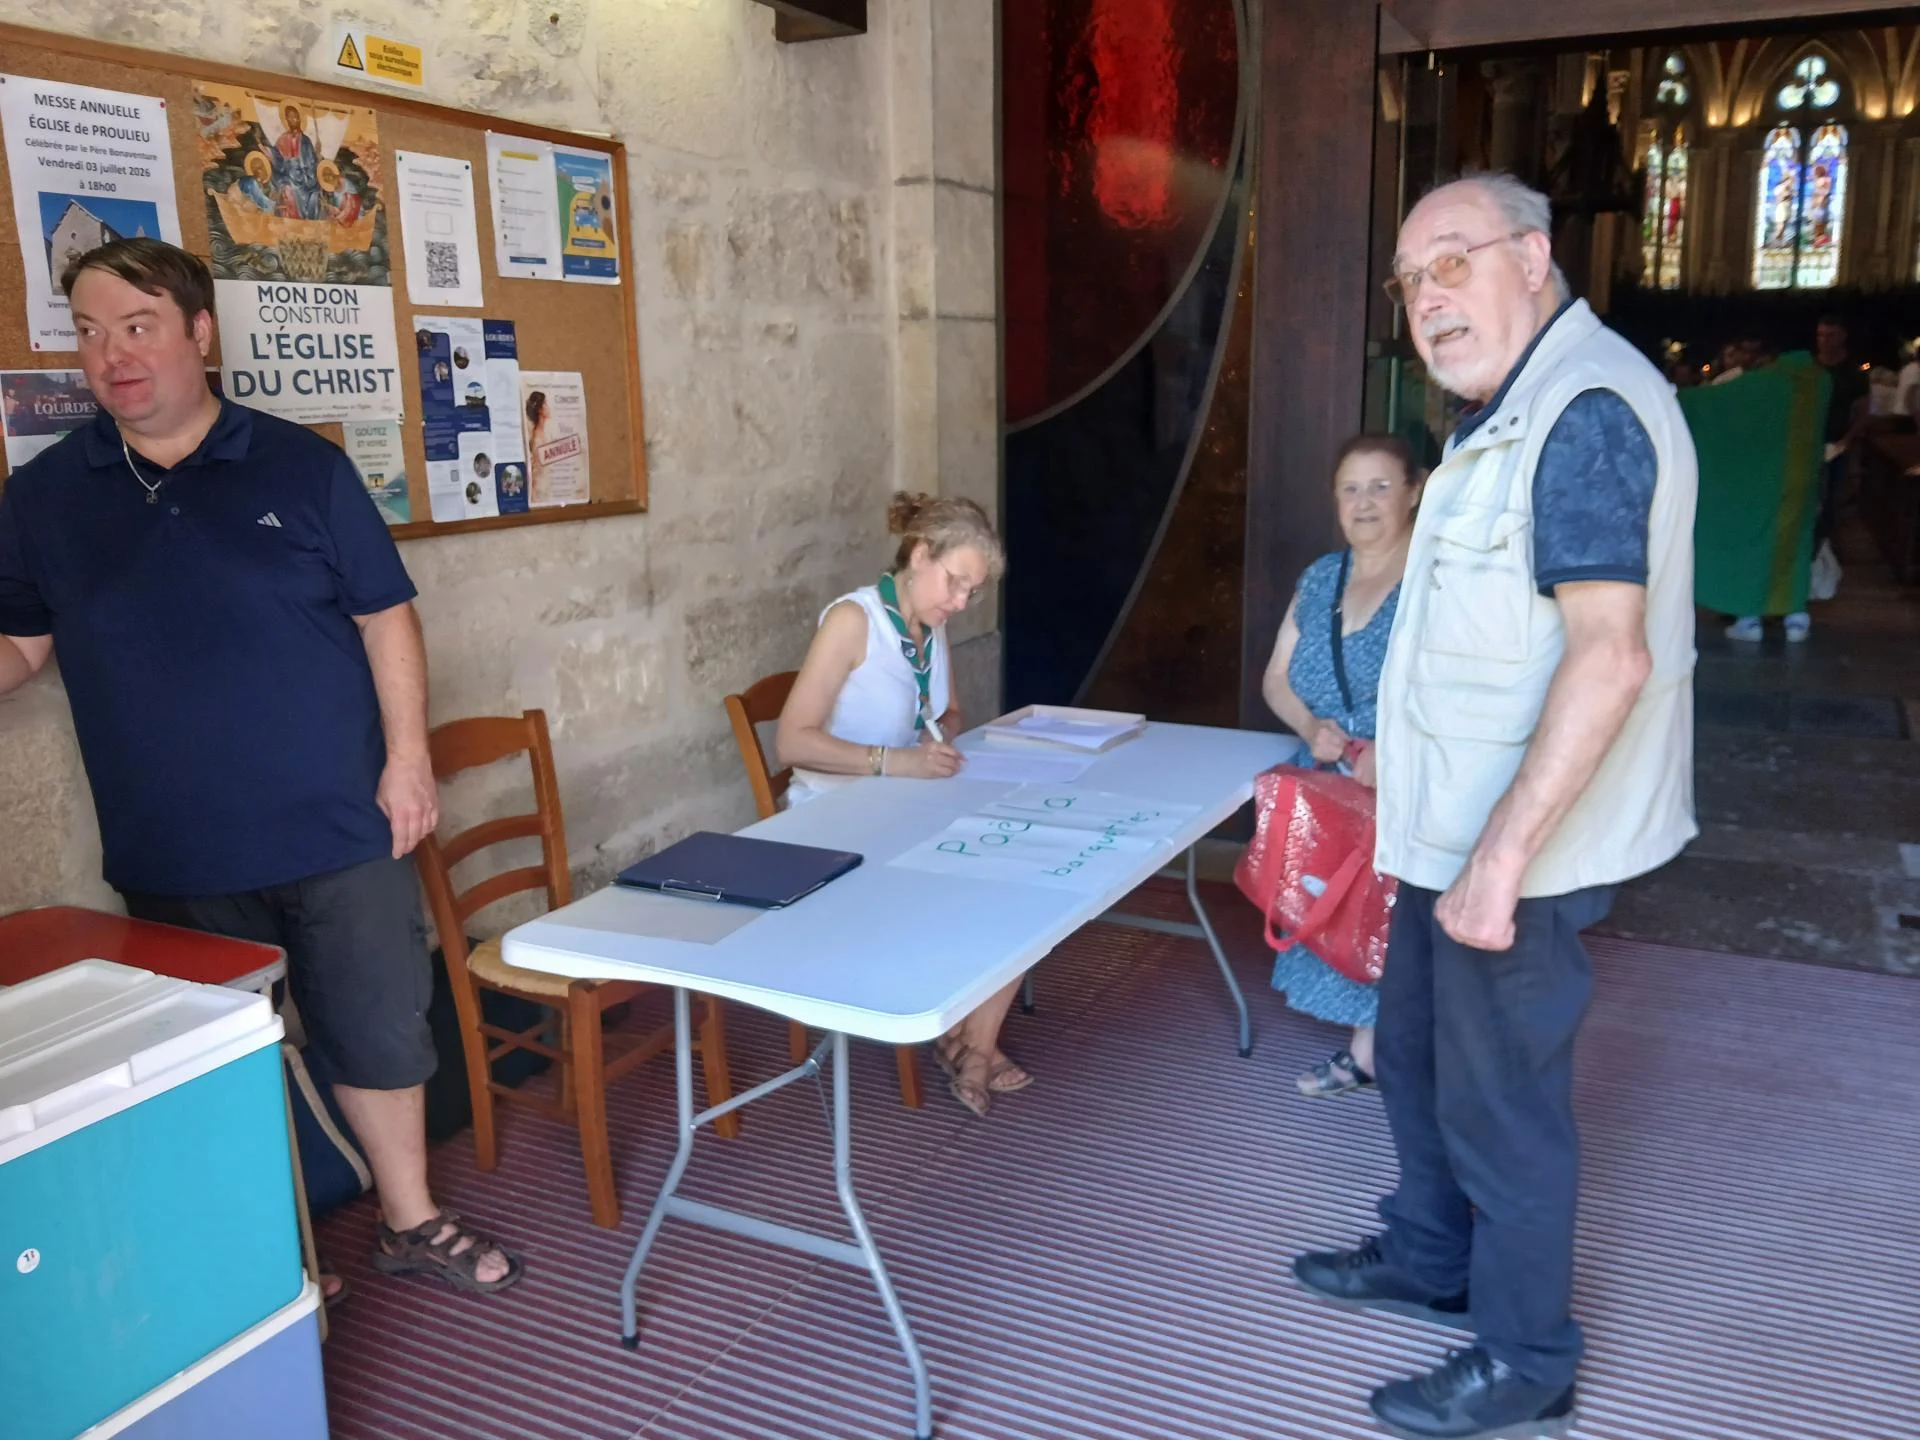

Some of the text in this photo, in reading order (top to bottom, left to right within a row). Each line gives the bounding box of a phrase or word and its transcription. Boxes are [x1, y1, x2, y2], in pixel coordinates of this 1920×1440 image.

[34, 93, 141, 119] MESSE ANNUELLE
[29, 114, 150, 143] ÉGLISE de PROULIEU
[25, 137, 158, 161] Célébrée par le Père Bonaventure
[38, 156, 151, 177] Vendredi 03 juillet 2026
[79, 180, 116, 192] à 18h00
[257, 285, 358, 305] MON DON
[259, 305, 360, 324] CONSTRUIT
[250, 326, 375, 360] L'ÉGLISE
[232, 368, 395, 397] DU CHRIST
[34, 401, 98, 416] LOURDES
